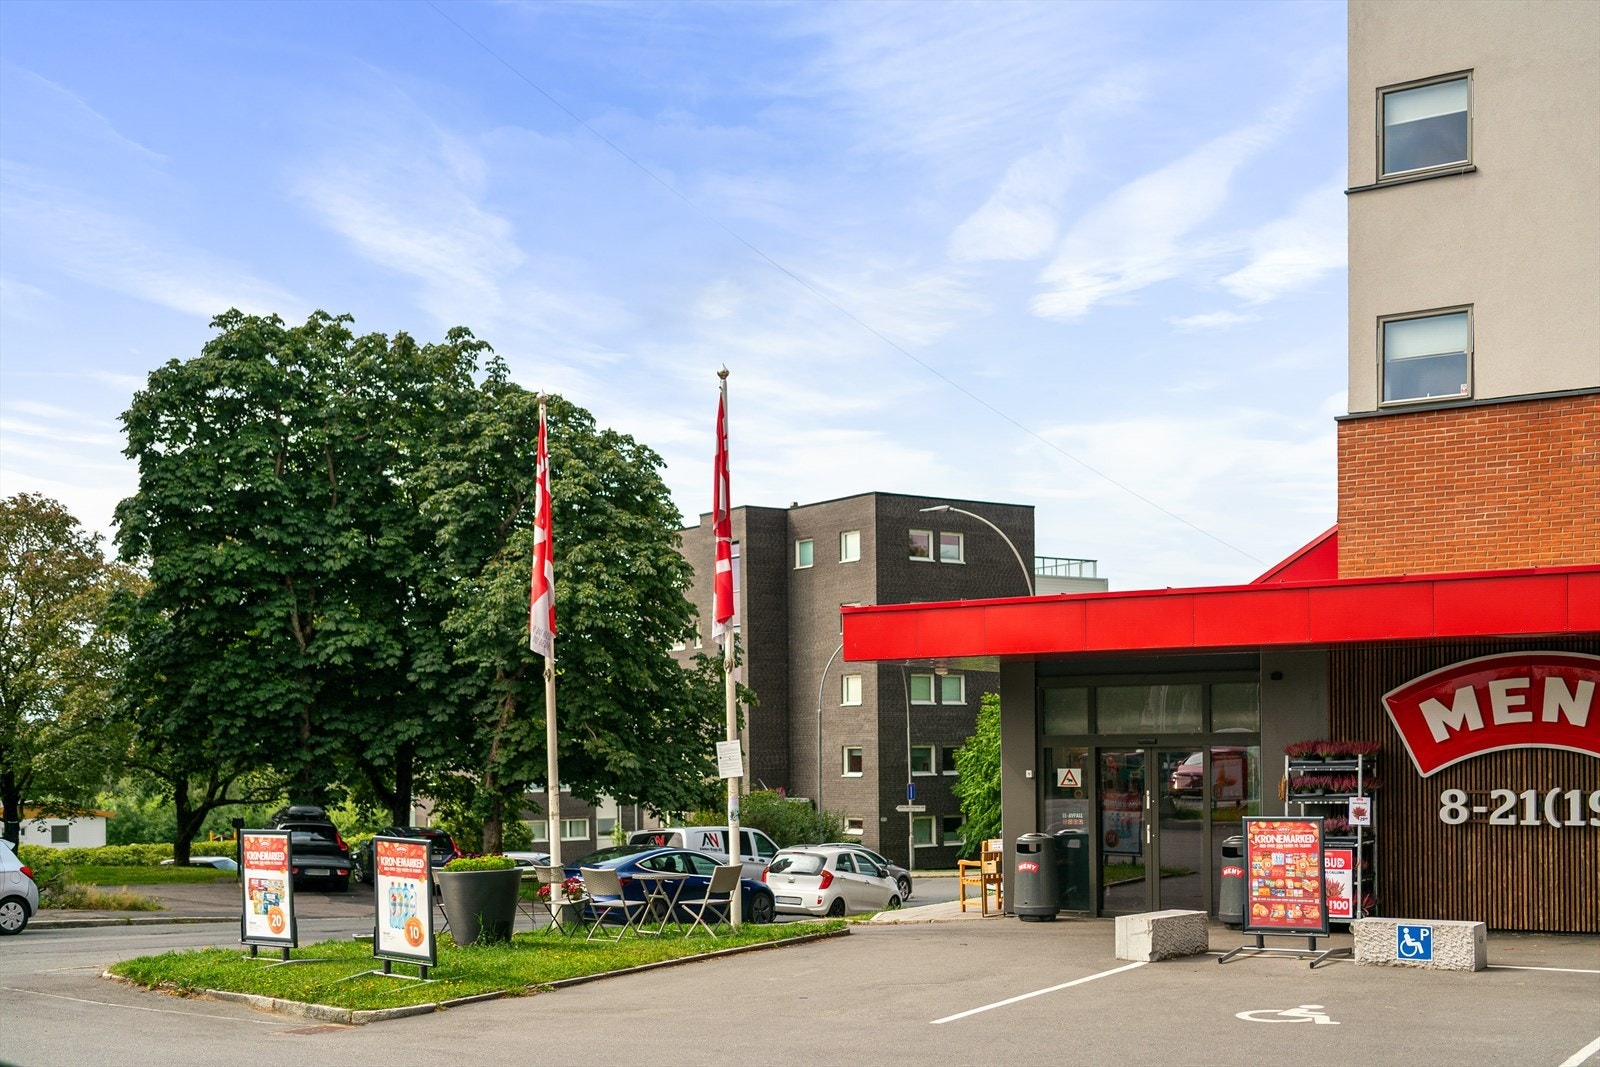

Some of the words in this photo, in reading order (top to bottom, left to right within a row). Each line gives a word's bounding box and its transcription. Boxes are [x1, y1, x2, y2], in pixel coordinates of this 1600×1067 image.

[1419, 676, 1596, 744] MEN
[1254, 834, 1315, 843] KRONEMARKED
[246, 851, 285, 861] KRONEMARKED
[380, 856, 425, 869] KRONEMARKED
[1018, 863, 1037, 871] MENY
[1324, 857, 1345, 868] BUD
[1223, 867, 1242, 876] MENY
[1334, 900, 1349, 910] 100
[271, 914, 282, 927] 20
[409, 925, 419, 939] 10
[1420, 928, 1430, 941] P
